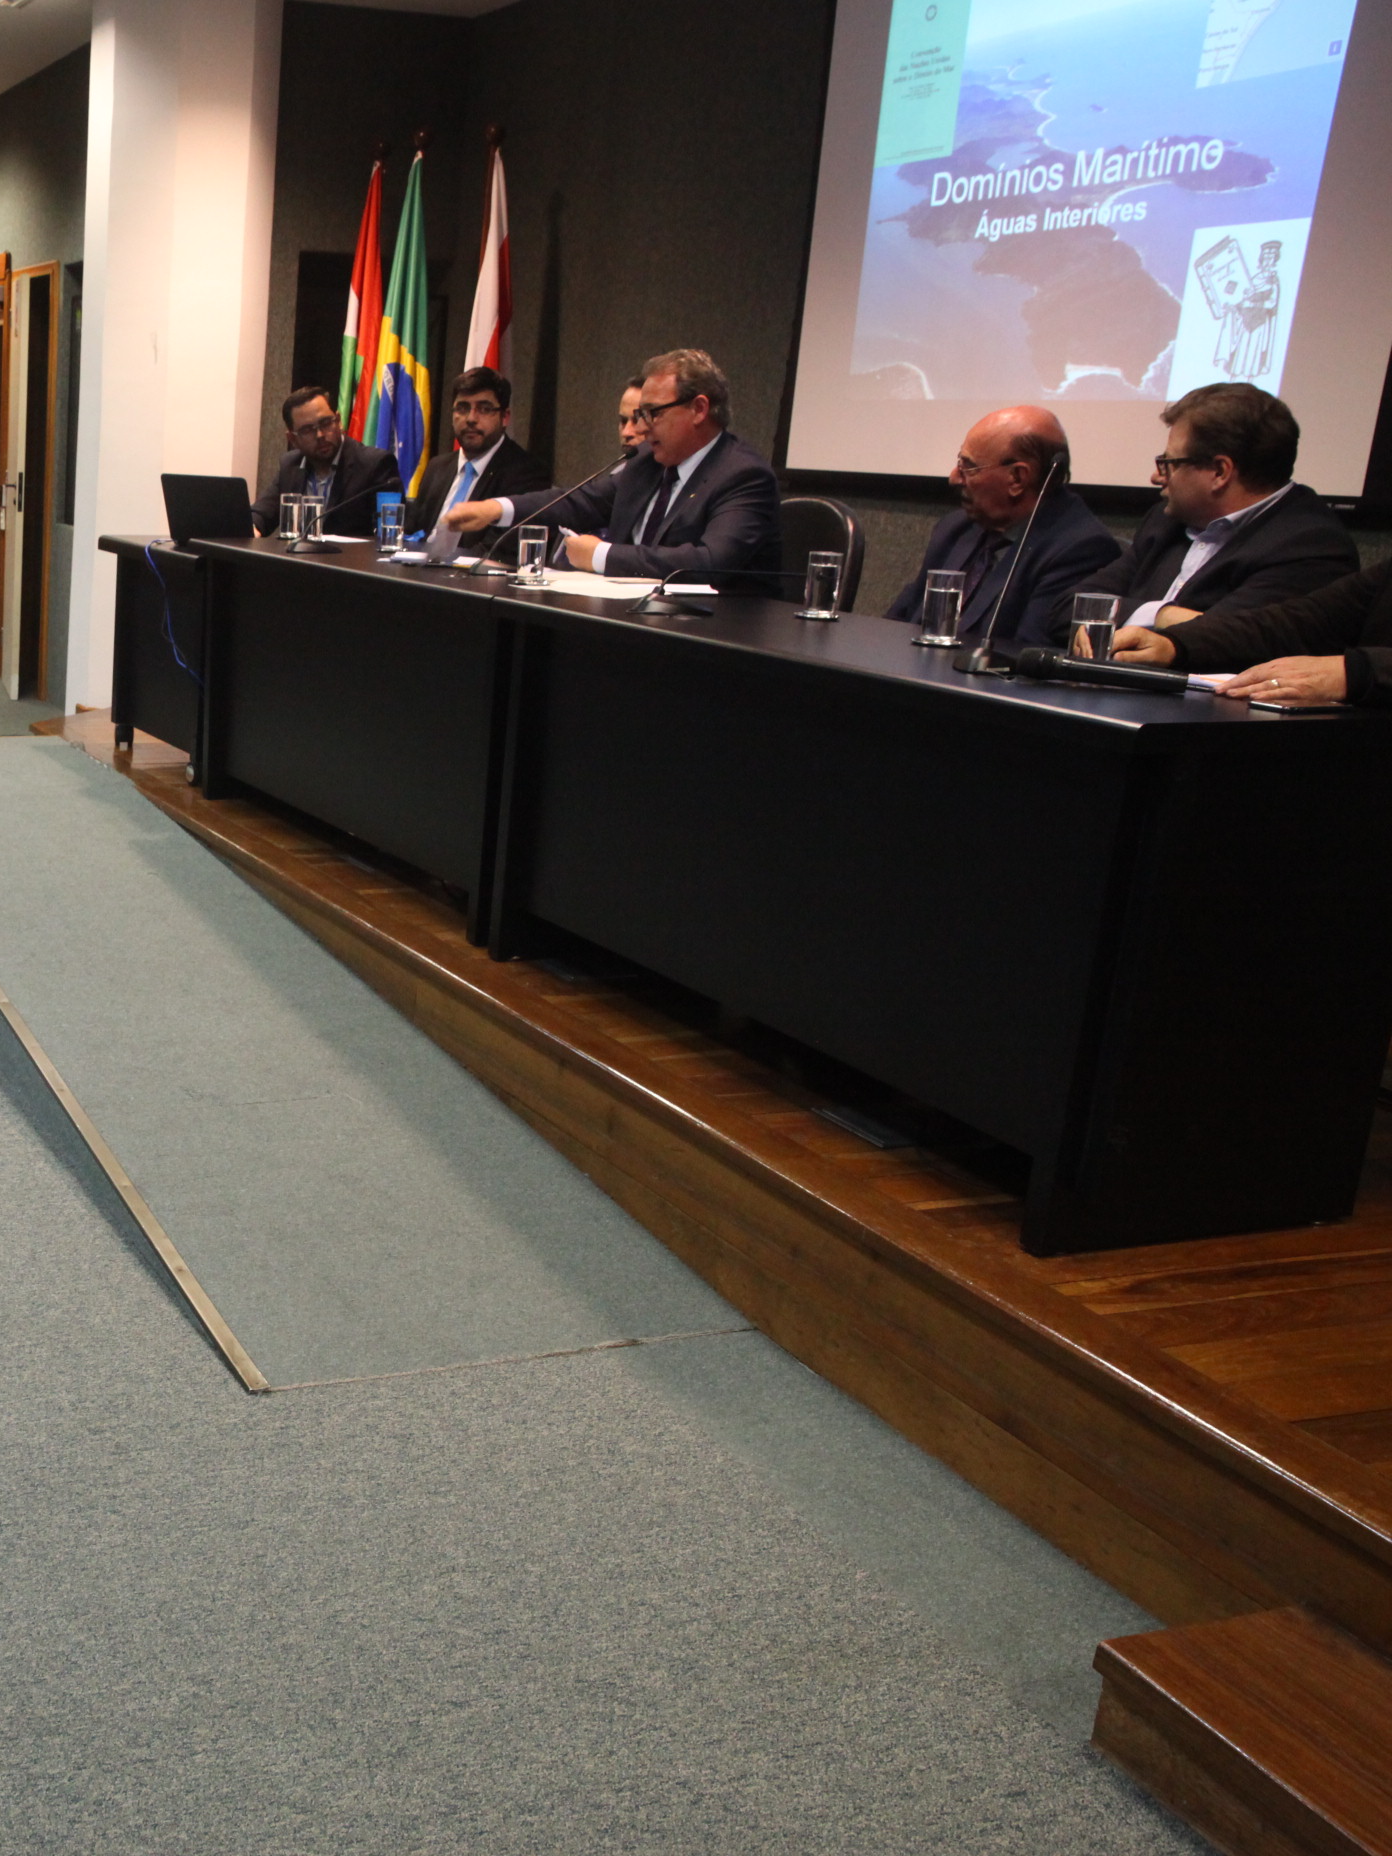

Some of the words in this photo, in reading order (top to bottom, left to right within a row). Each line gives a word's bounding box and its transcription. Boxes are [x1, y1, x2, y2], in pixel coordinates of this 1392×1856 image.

[930, 159, 1064, 207] Domínios
[1072, 137, 1224, 187] Marítimo
[974, 209, 1037, 243] Águas
[1043, 201, 1147, 231] Interiores
